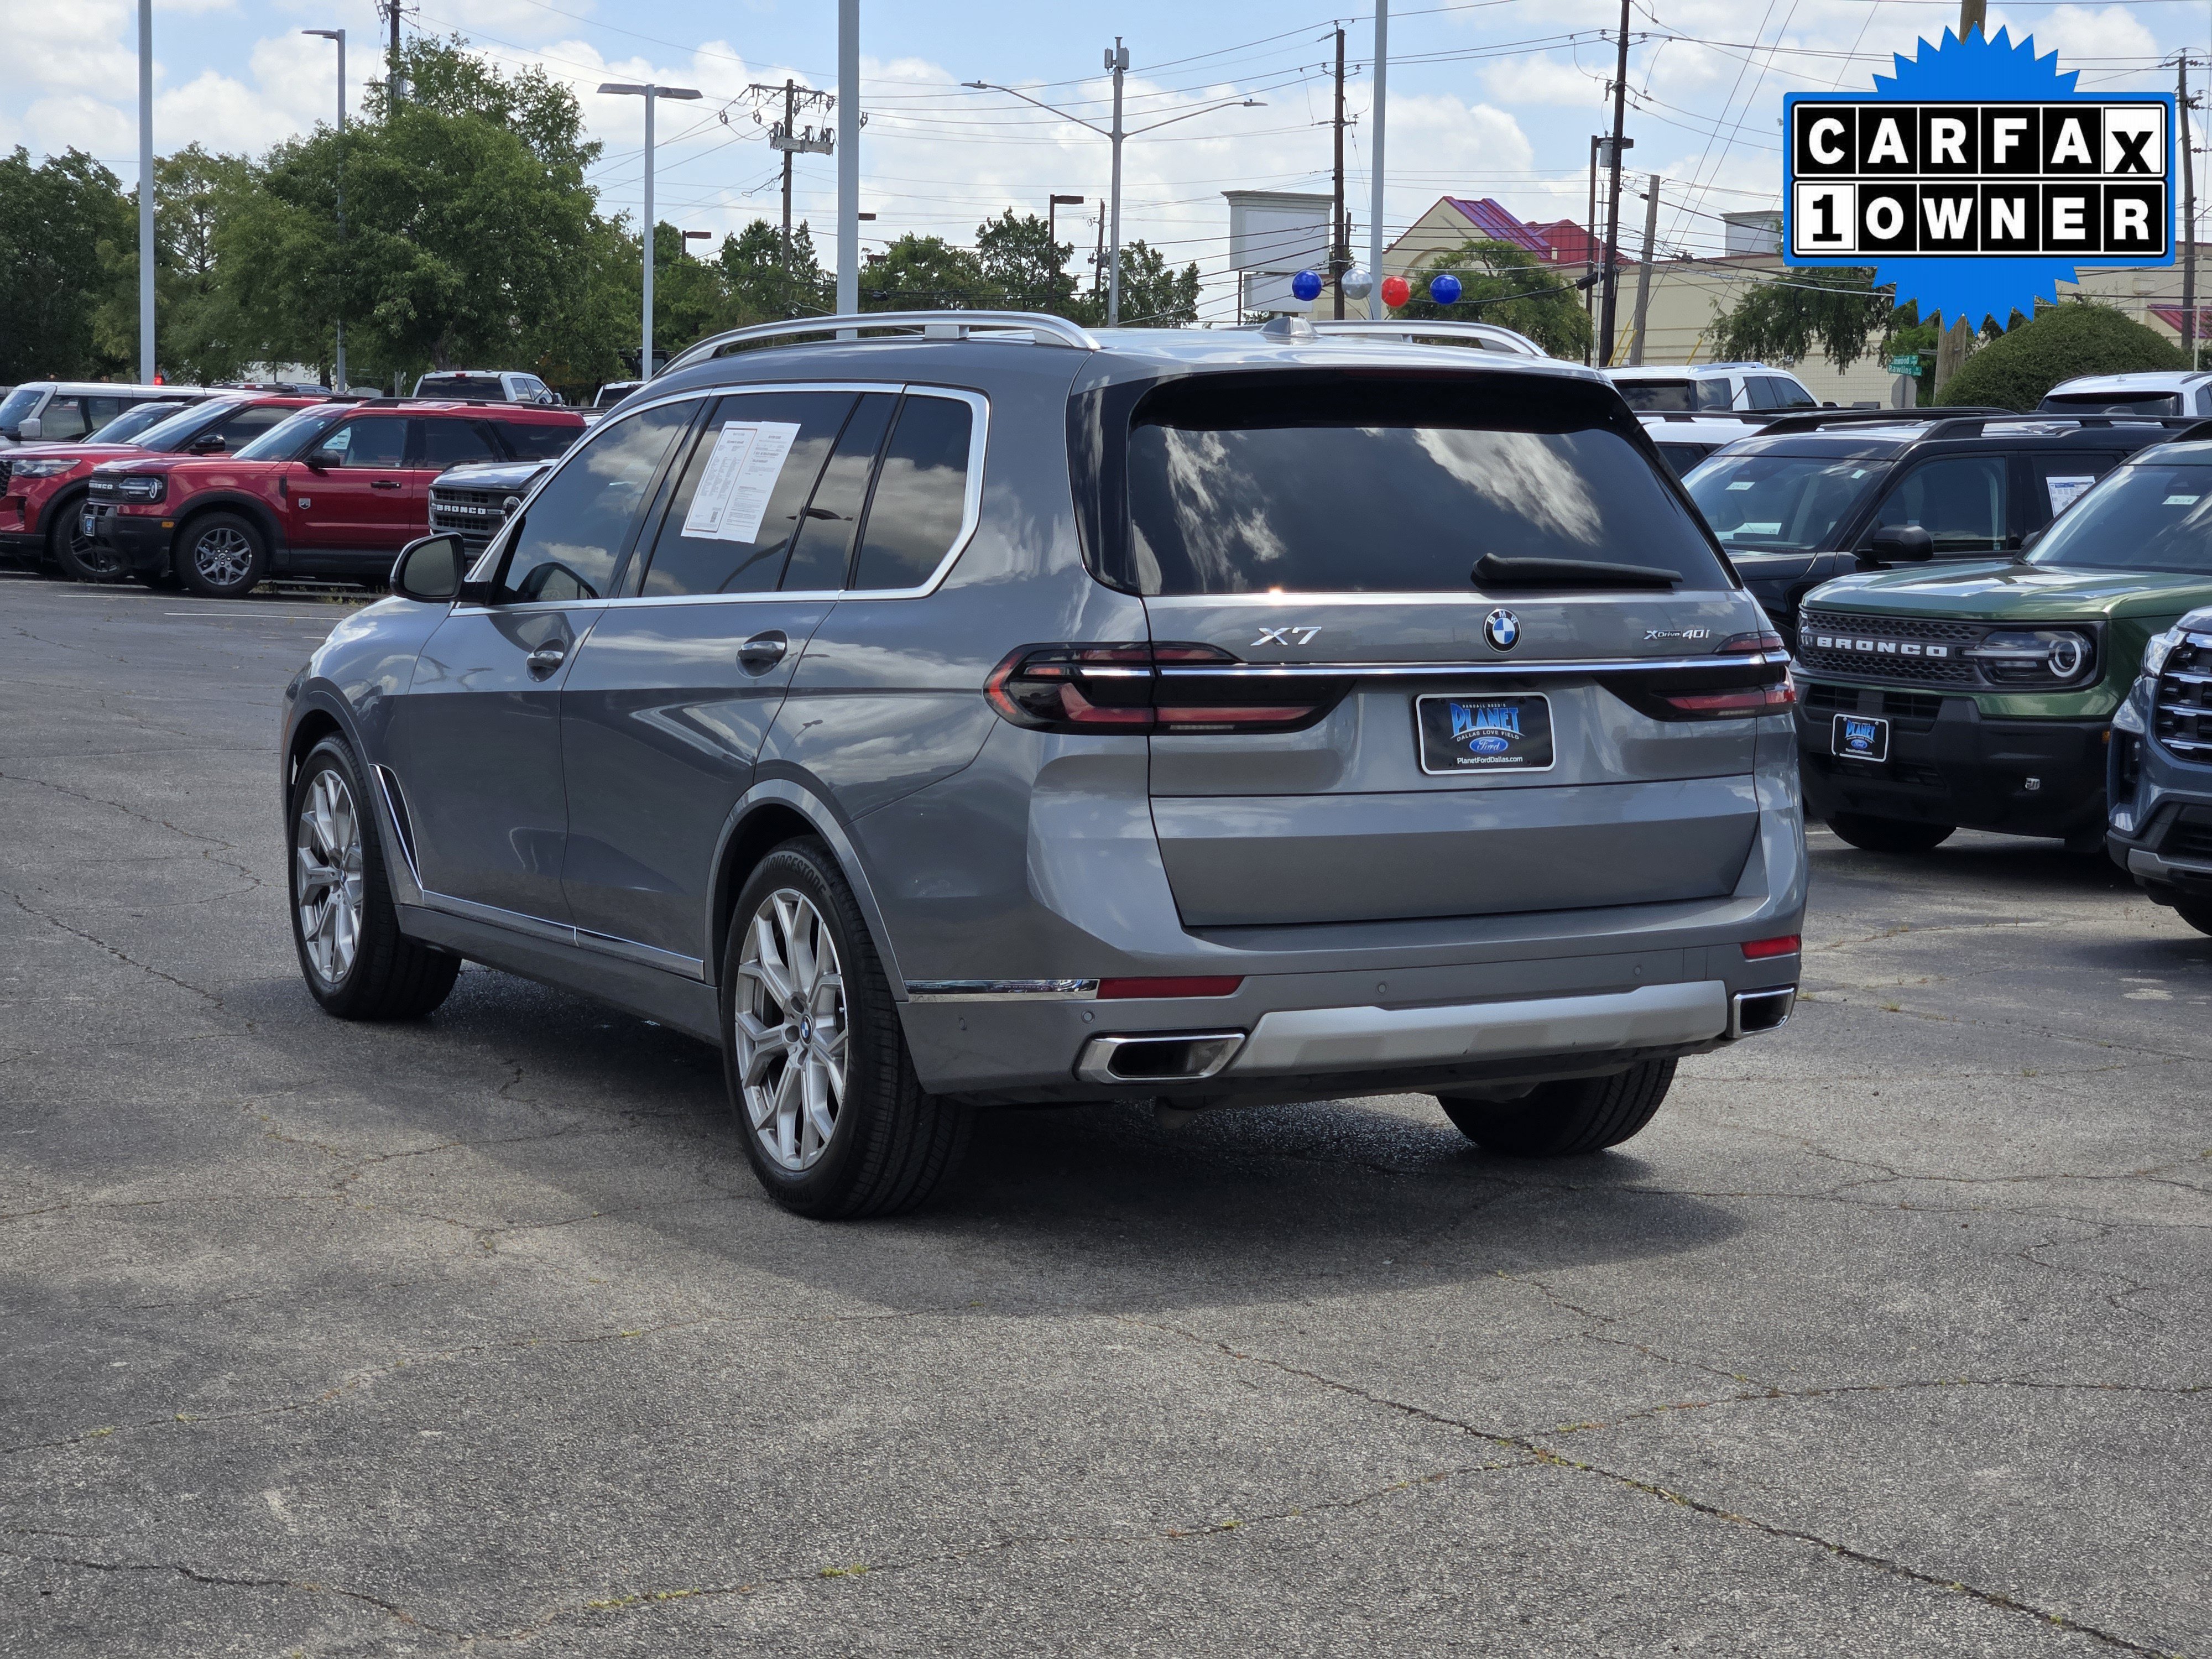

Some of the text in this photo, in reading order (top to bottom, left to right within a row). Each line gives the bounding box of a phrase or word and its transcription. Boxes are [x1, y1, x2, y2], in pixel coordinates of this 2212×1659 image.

[1888, 365, 1912, 374] Rawlins
[437, 504, 486, 514] BRONCO
[1488, 611, 1518, 624] BMW
[1250, 627, 1322, 646] X7
[1817, 637, 1947, 657] BRONCO
[1450, 703, 1520, 736] PLANET
[1846, 720, 1875, 740] PLANET
[1457, 731, 1480, 742] DALLAS
[1501, 731, 1519, 740] FIELD
[1477, 739, 1501, 751] Ford
[1457, 755, 1523, 764] PlanetFordDallas.com
